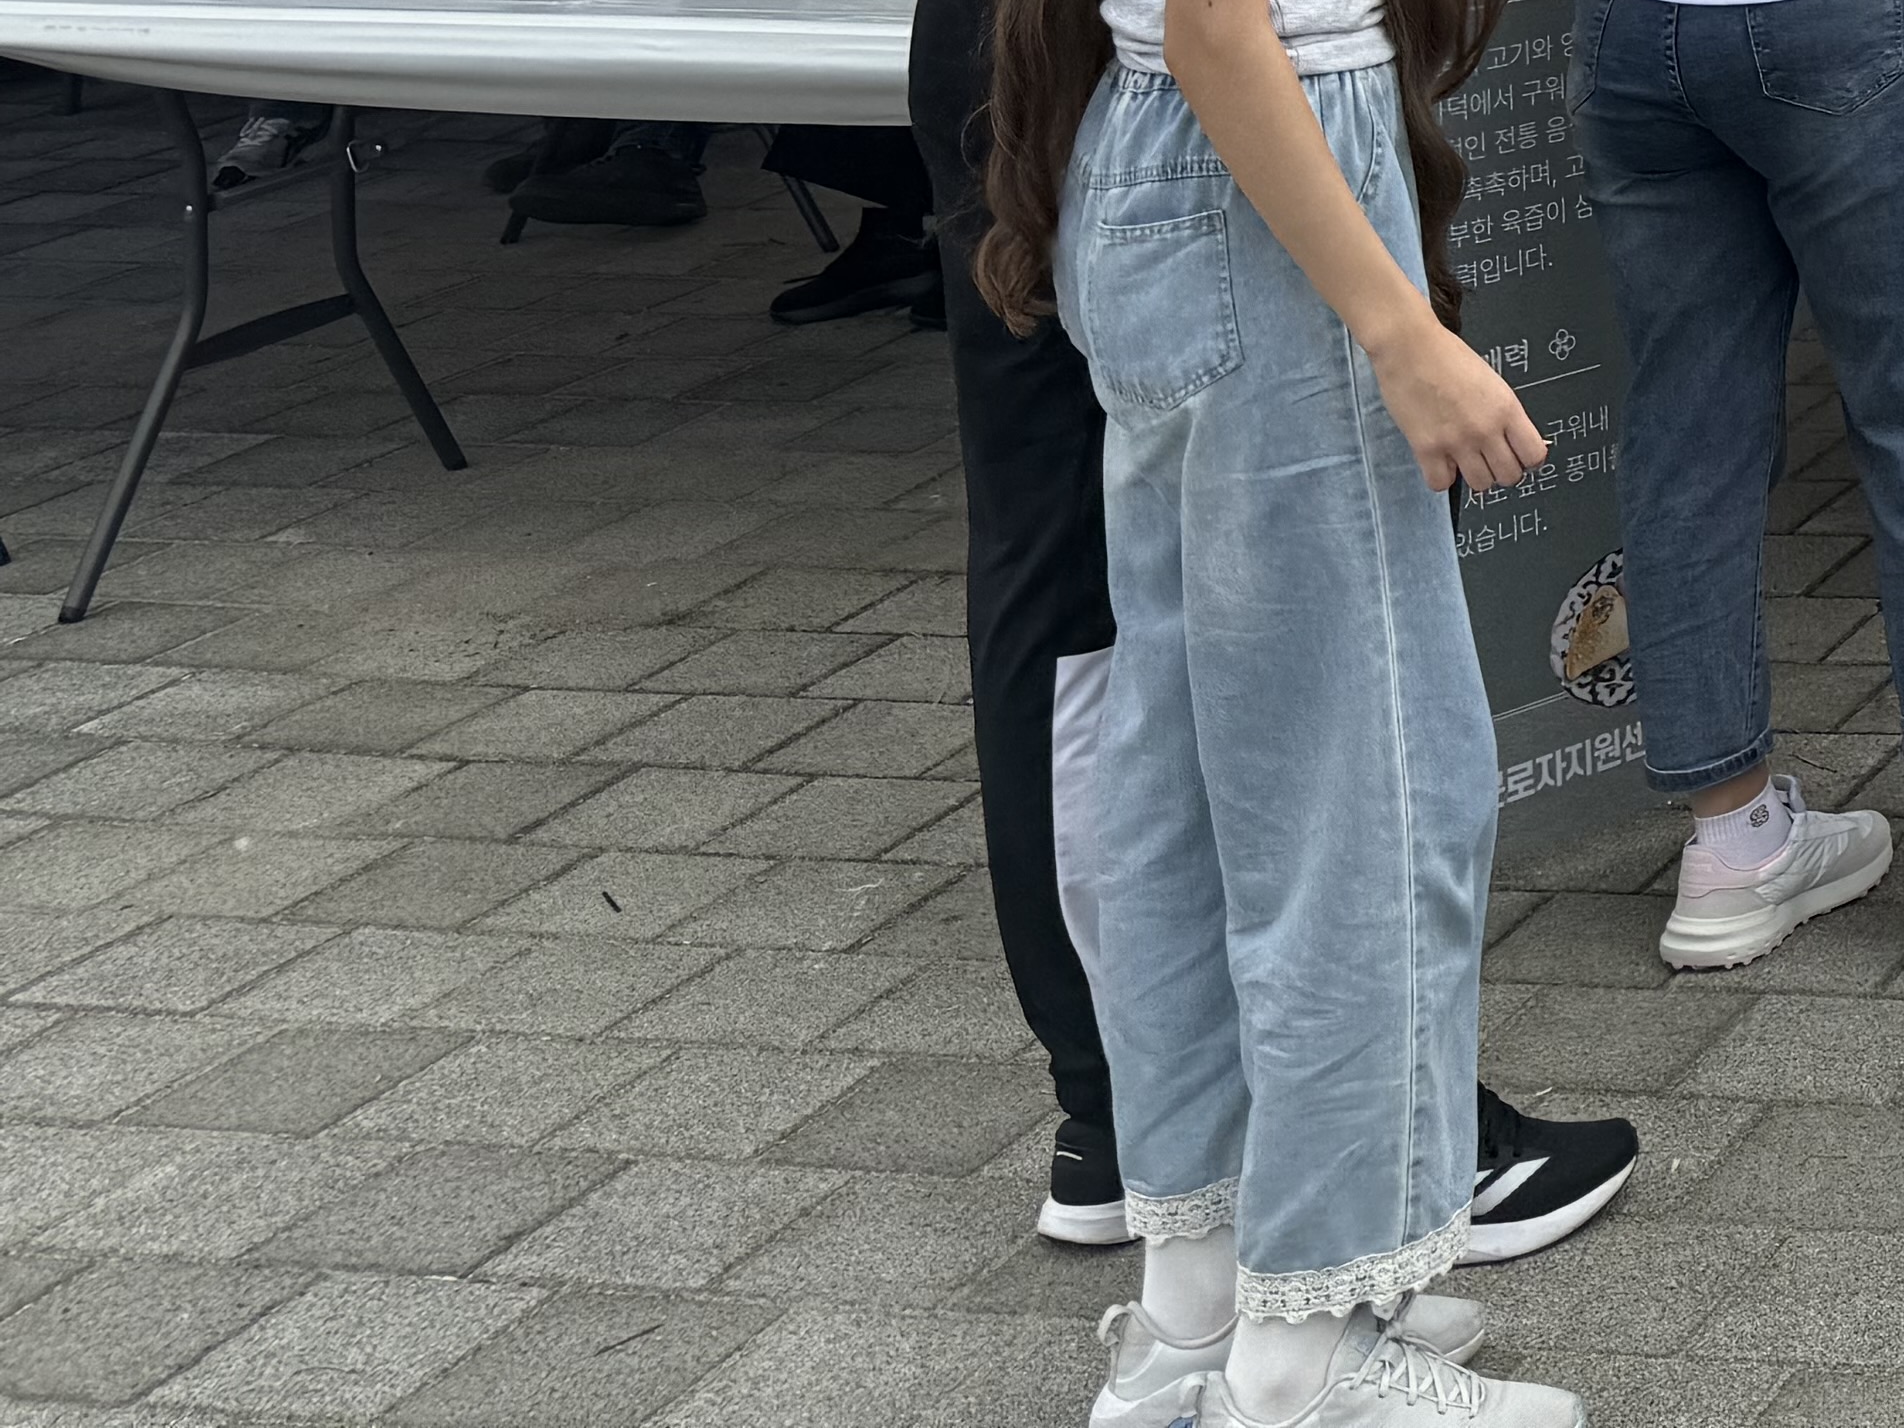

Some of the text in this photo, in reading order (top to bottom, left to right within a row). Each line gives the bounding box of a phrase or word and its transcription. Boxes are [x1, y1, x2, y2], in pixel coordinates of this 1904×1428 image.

[1495, 120, 1538, 155] 전통
[1500, 201, 1566, 236] 육즙이
[1456, 244, 1554, 287] 력입니다.
[1498, 721, 1645, 810] 로자지원센
